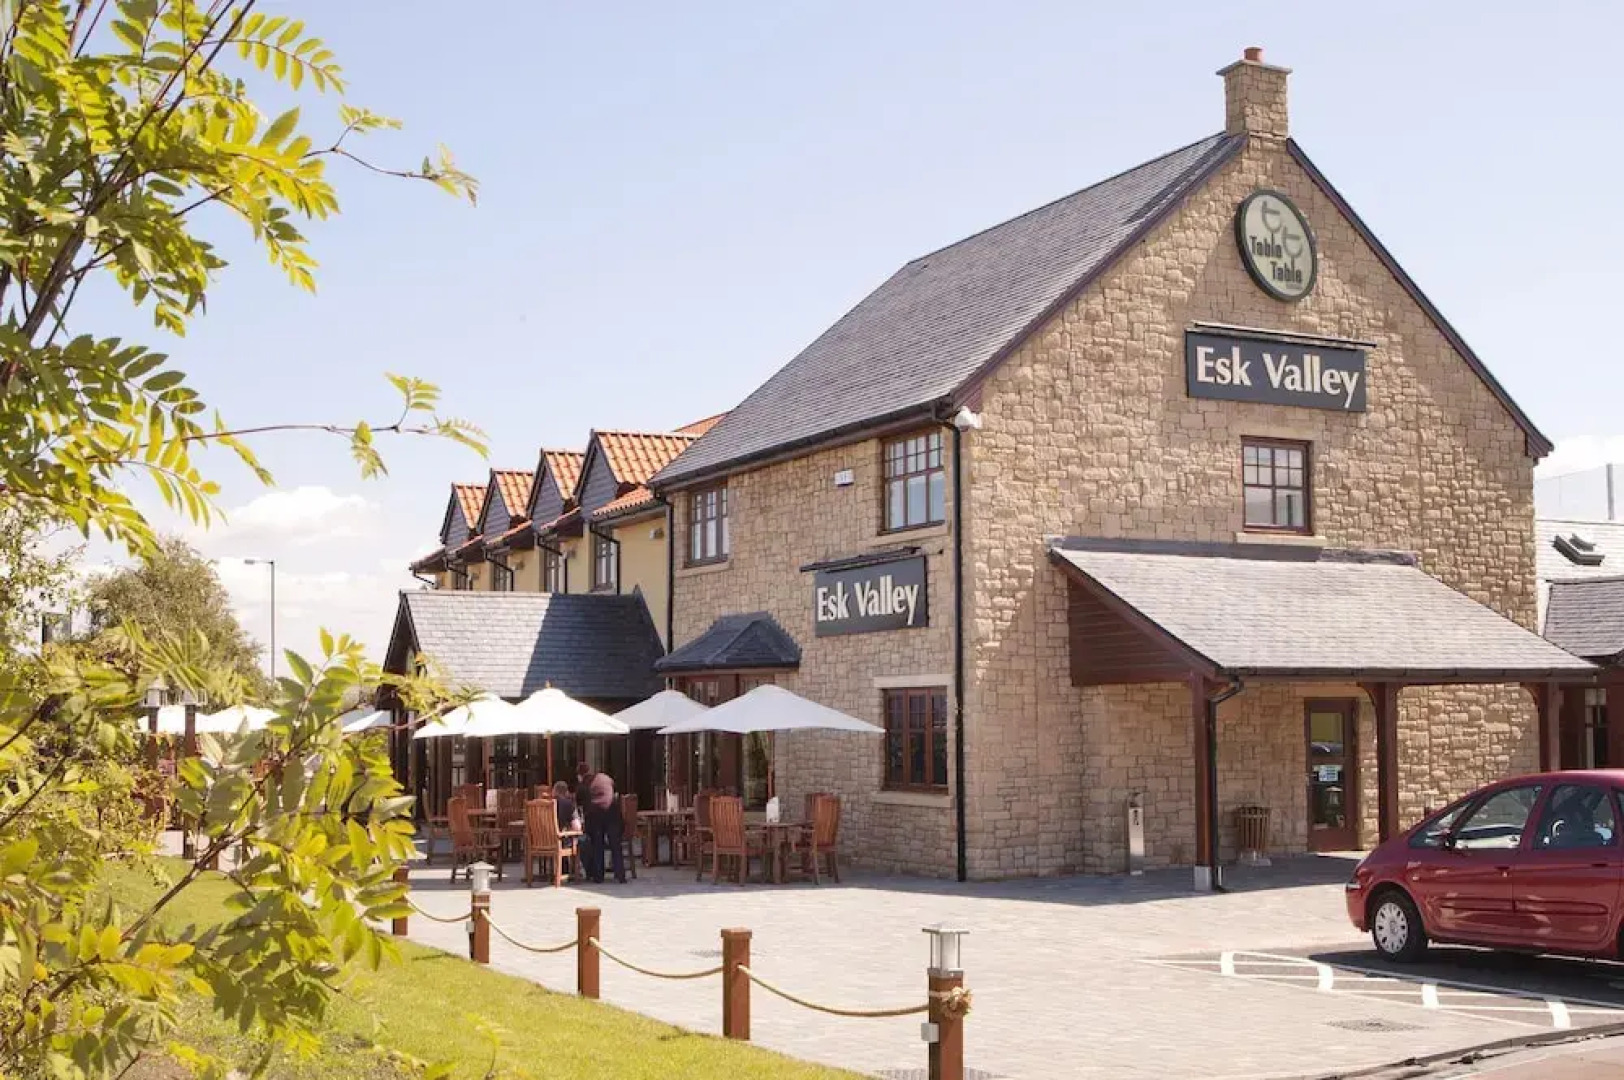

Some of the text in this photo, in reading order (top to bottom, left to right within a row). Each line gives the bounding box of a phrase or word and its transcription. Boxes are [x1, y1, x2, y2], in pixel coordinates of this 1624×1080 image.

[1249, 234, 1283, 258] Table
[1270, 260, 1302, 283] Table
[1196, 345, 1359, 409] Esk Valley
[817, 574, 919, 626] Esk Valley
